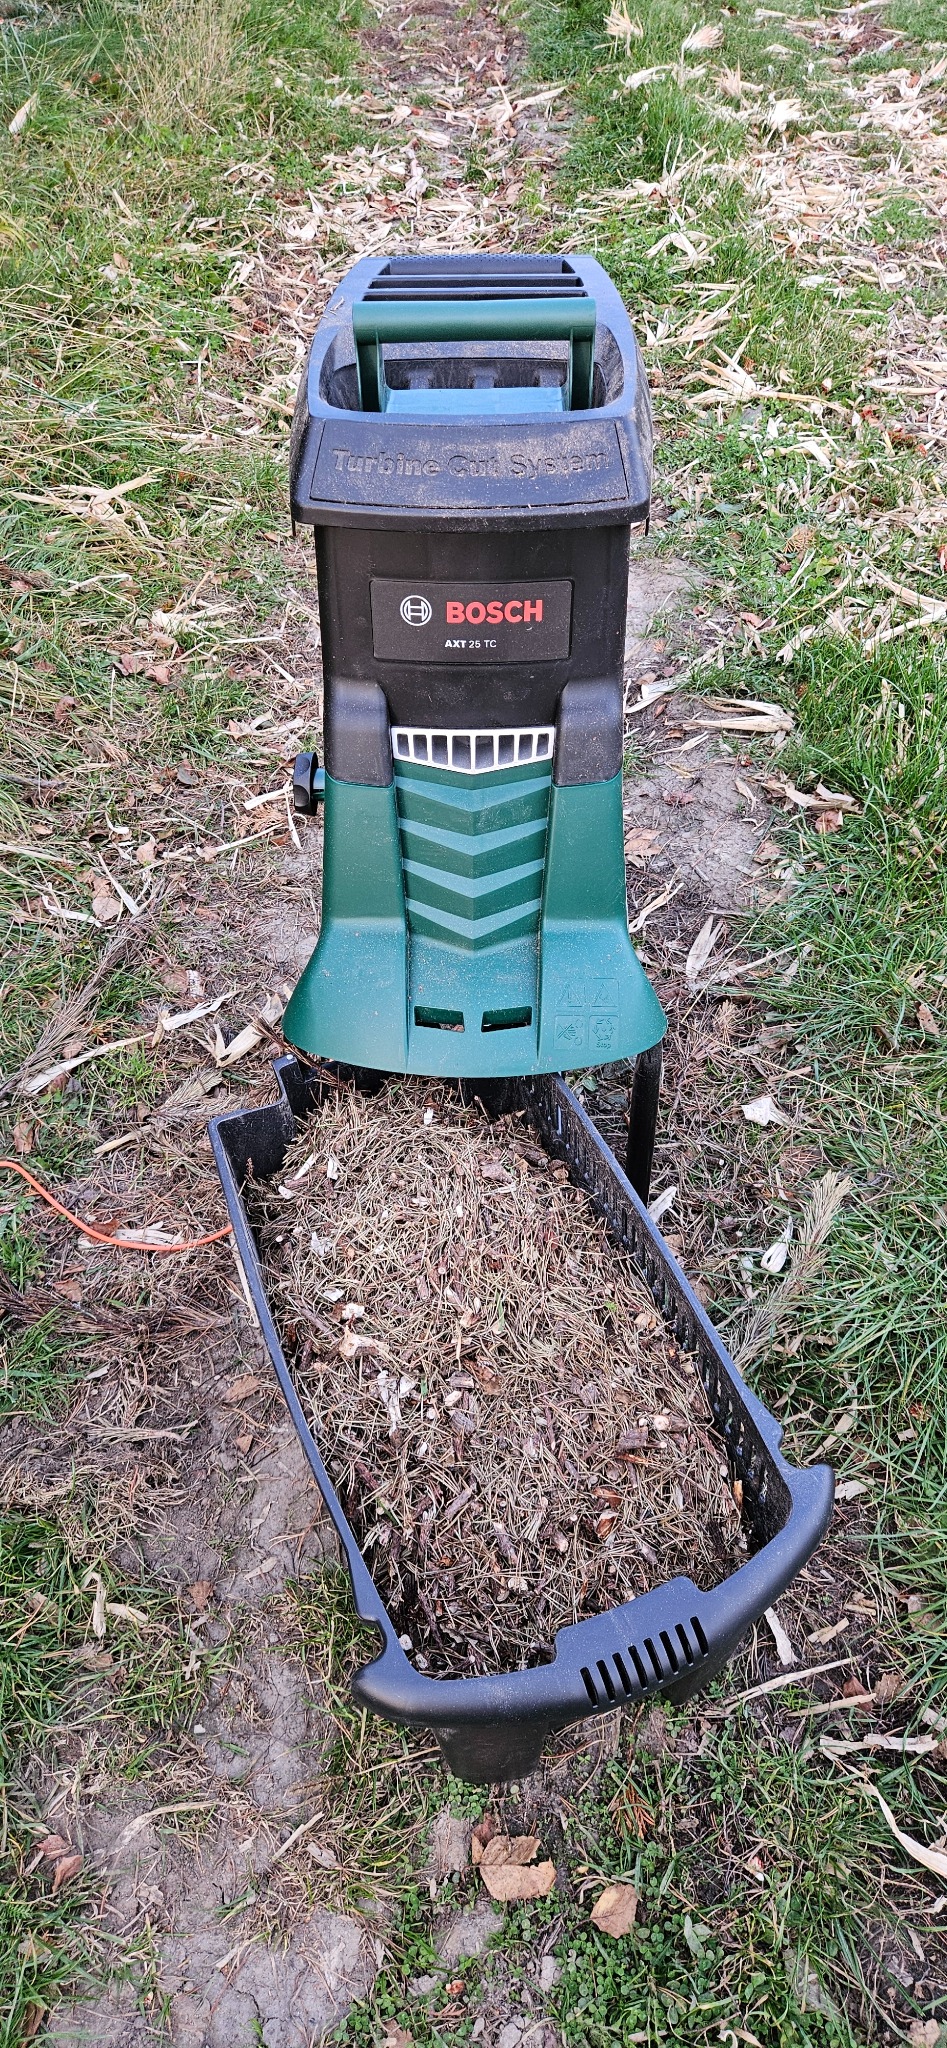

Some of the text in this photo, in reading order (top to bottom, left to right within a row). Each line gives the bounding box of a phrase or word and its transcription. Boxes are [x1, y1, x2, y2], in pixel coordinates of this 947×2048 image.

[333, 448, 610, 479] Turbine Cut System
[446, 600, 543, 624] BOSCH
[445, 639, 498, 649] AXT 25 TC
